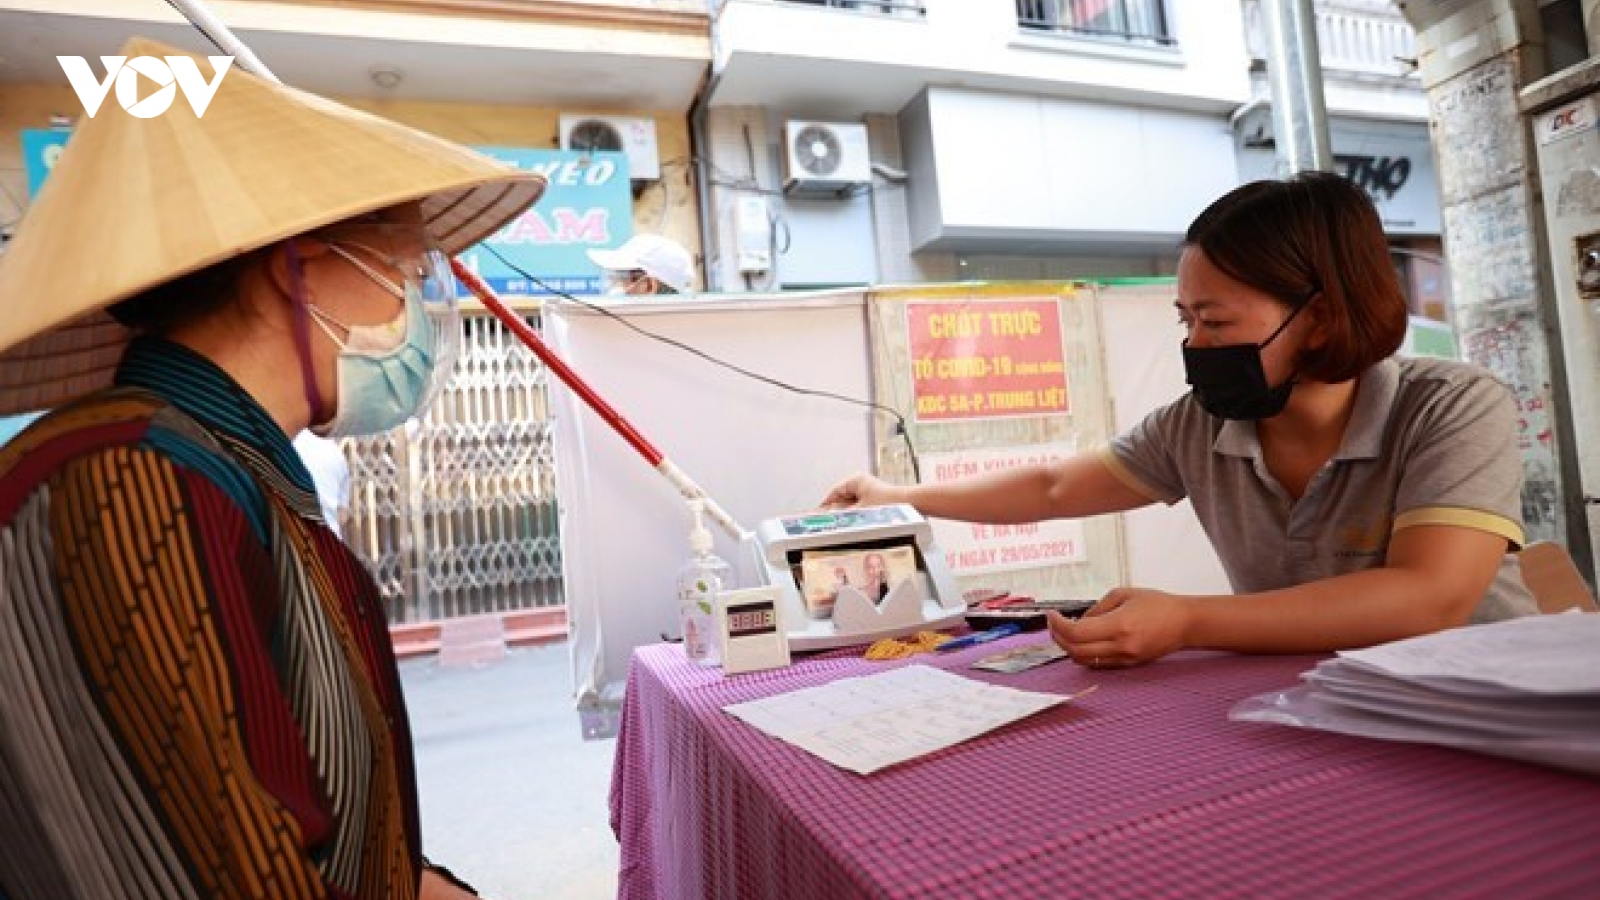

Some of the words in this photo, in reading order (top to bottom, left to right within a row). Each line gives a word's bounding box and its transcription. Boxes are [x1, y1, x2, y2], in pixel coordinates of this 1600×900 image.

[490, 206, 611, 244] AM
[929, 308, 982, 338] CHỐT
[989, 309, 1041, 340] TRỰC
